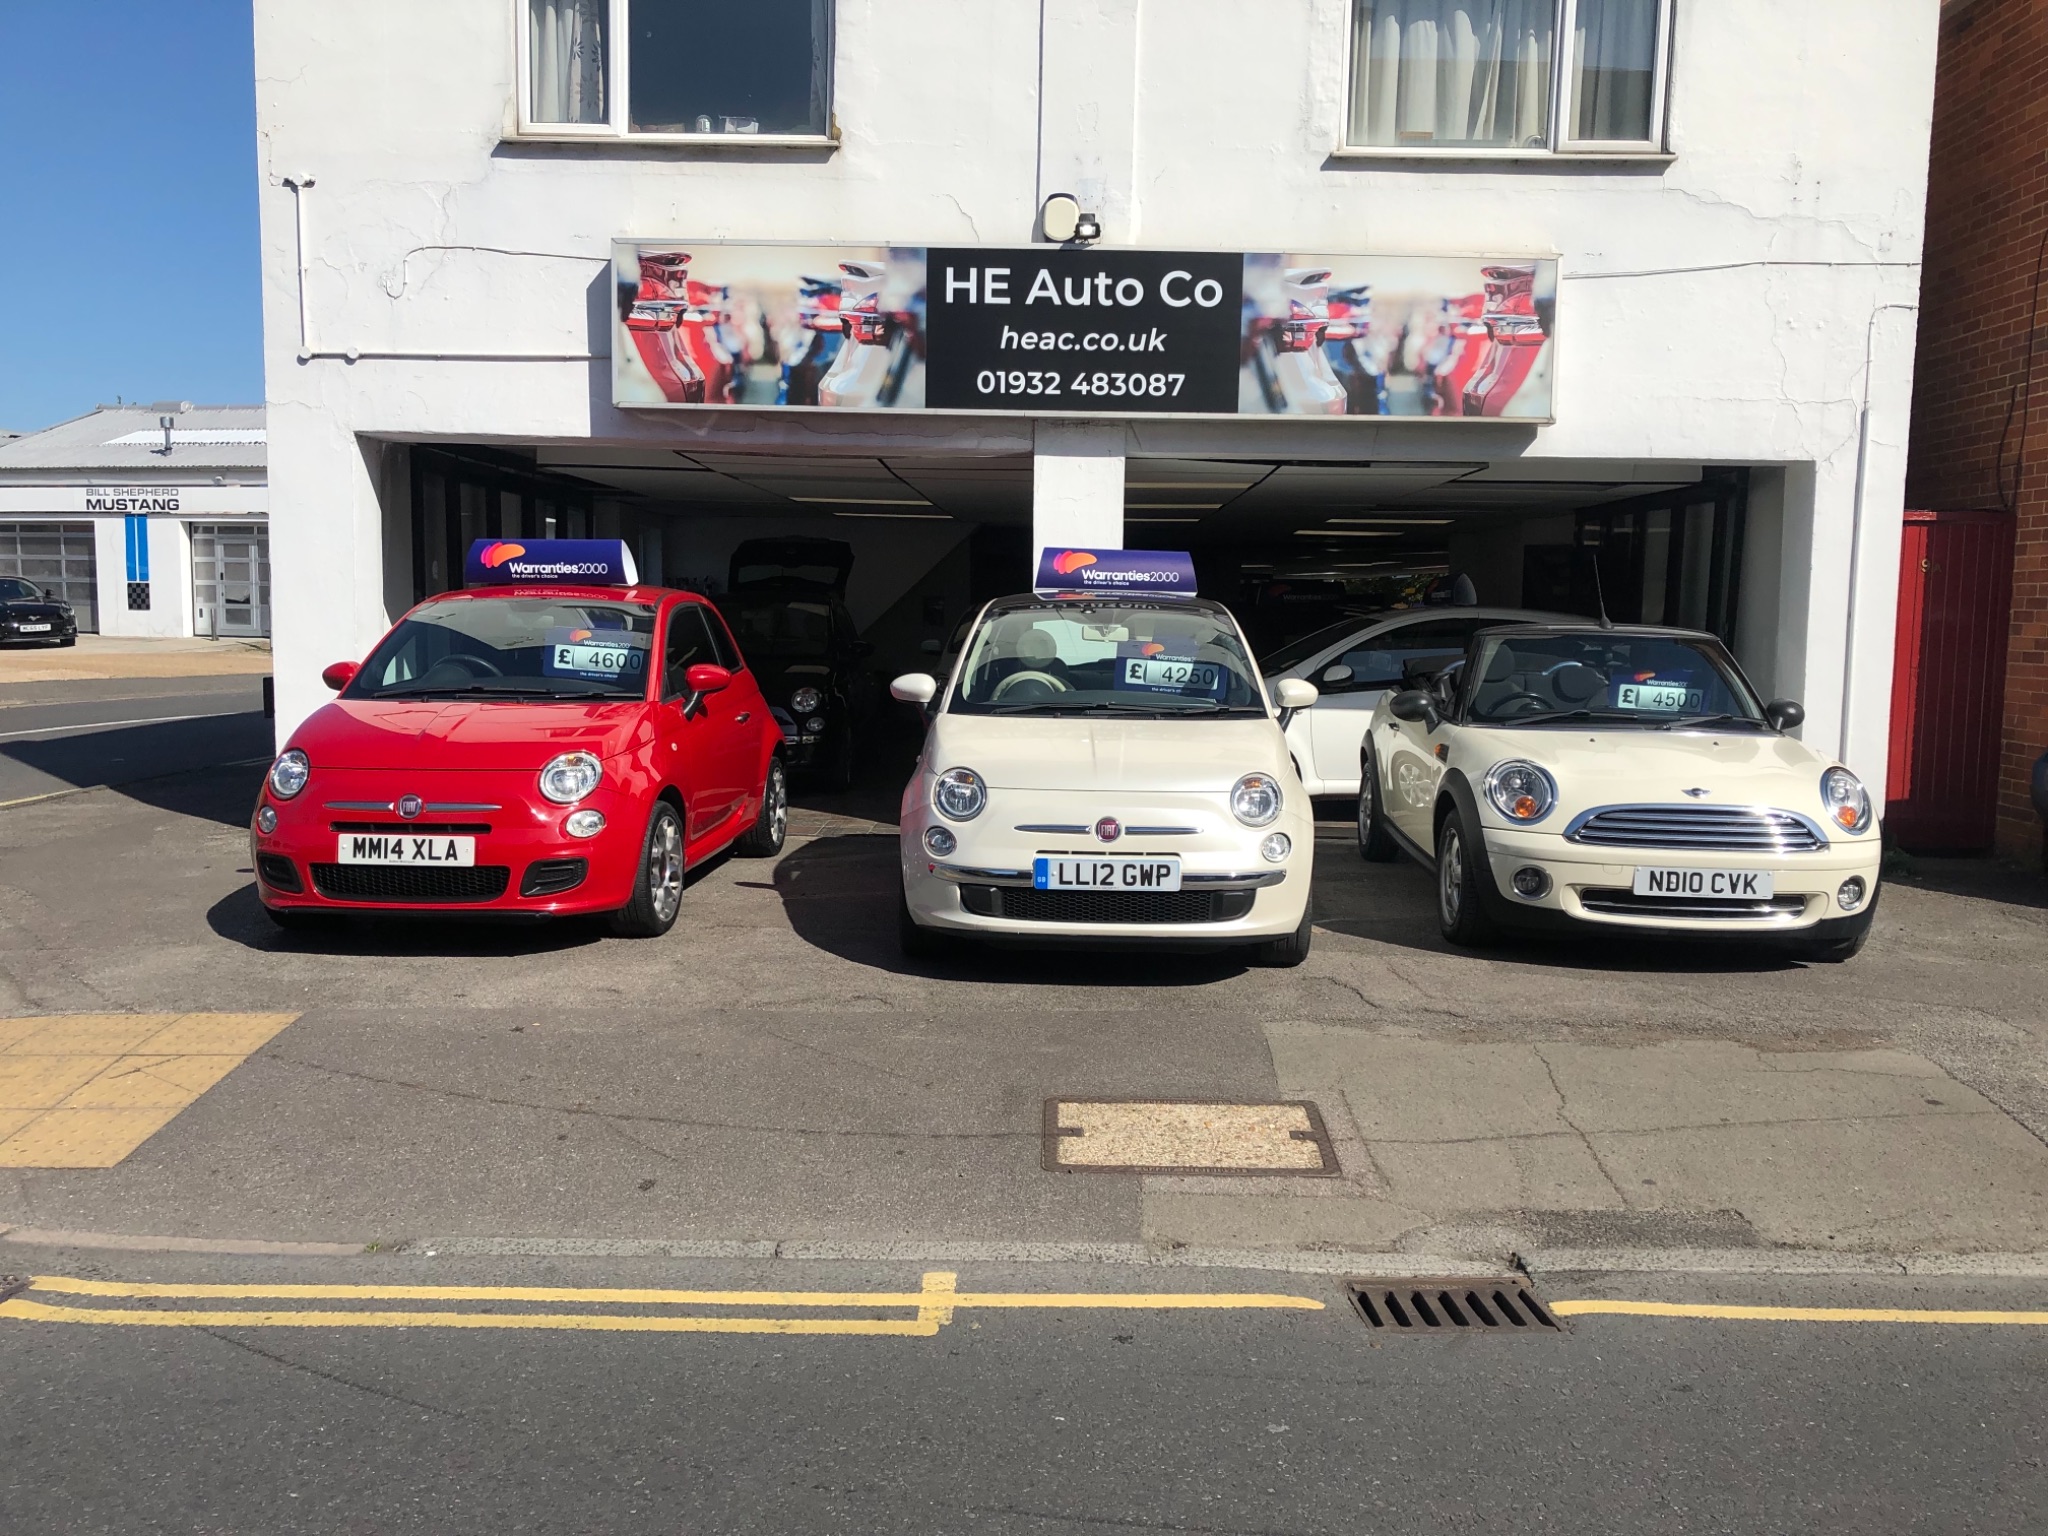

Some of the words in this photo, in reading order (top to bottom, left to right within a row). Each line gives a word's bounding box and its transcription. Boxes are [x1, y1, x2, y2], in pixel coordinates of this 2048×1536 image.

[945, 266, 1011, 305] HE
[1025, 268, 1144, 307] Auto
[1159, 270, 1223, 308] Co
[1000, 325, 1168, 352] heac.co.uk
[977, 370, 1061, 395] 01932
[1070, 373, 1186, 397] 483087
[86, 488, 110, 497] BILL
[113, 488, 179, 497] SHEPHERD
[86, 498, 180, 511] MUSTANG
[508, 562, 608, 575] Warranties2000
[1081, 569, 1180, 582] Warranties2000
[558, 648, 572, 665] £
[588, 651, 641, 670] 4600
[1129, 663, 1143, 680] £
[1161, 666, 1214, 685] 4250
[1621, 688, 1634, 704] £
[1652, 691, 1700, 709] 4500
[403, 801, 417, 812] FIAT
[1100, 825, 1116, 836] FIAT
[352, 836, 404, 860] MM14
[412, 838, 458, 861] XLA
[1059, 862, 1115, 886] LL12
[1122, 863, 1171, 887] GWP
[1649, 870, 1704, 894] ND10
[1711, 872, 1758, 895] CVK
